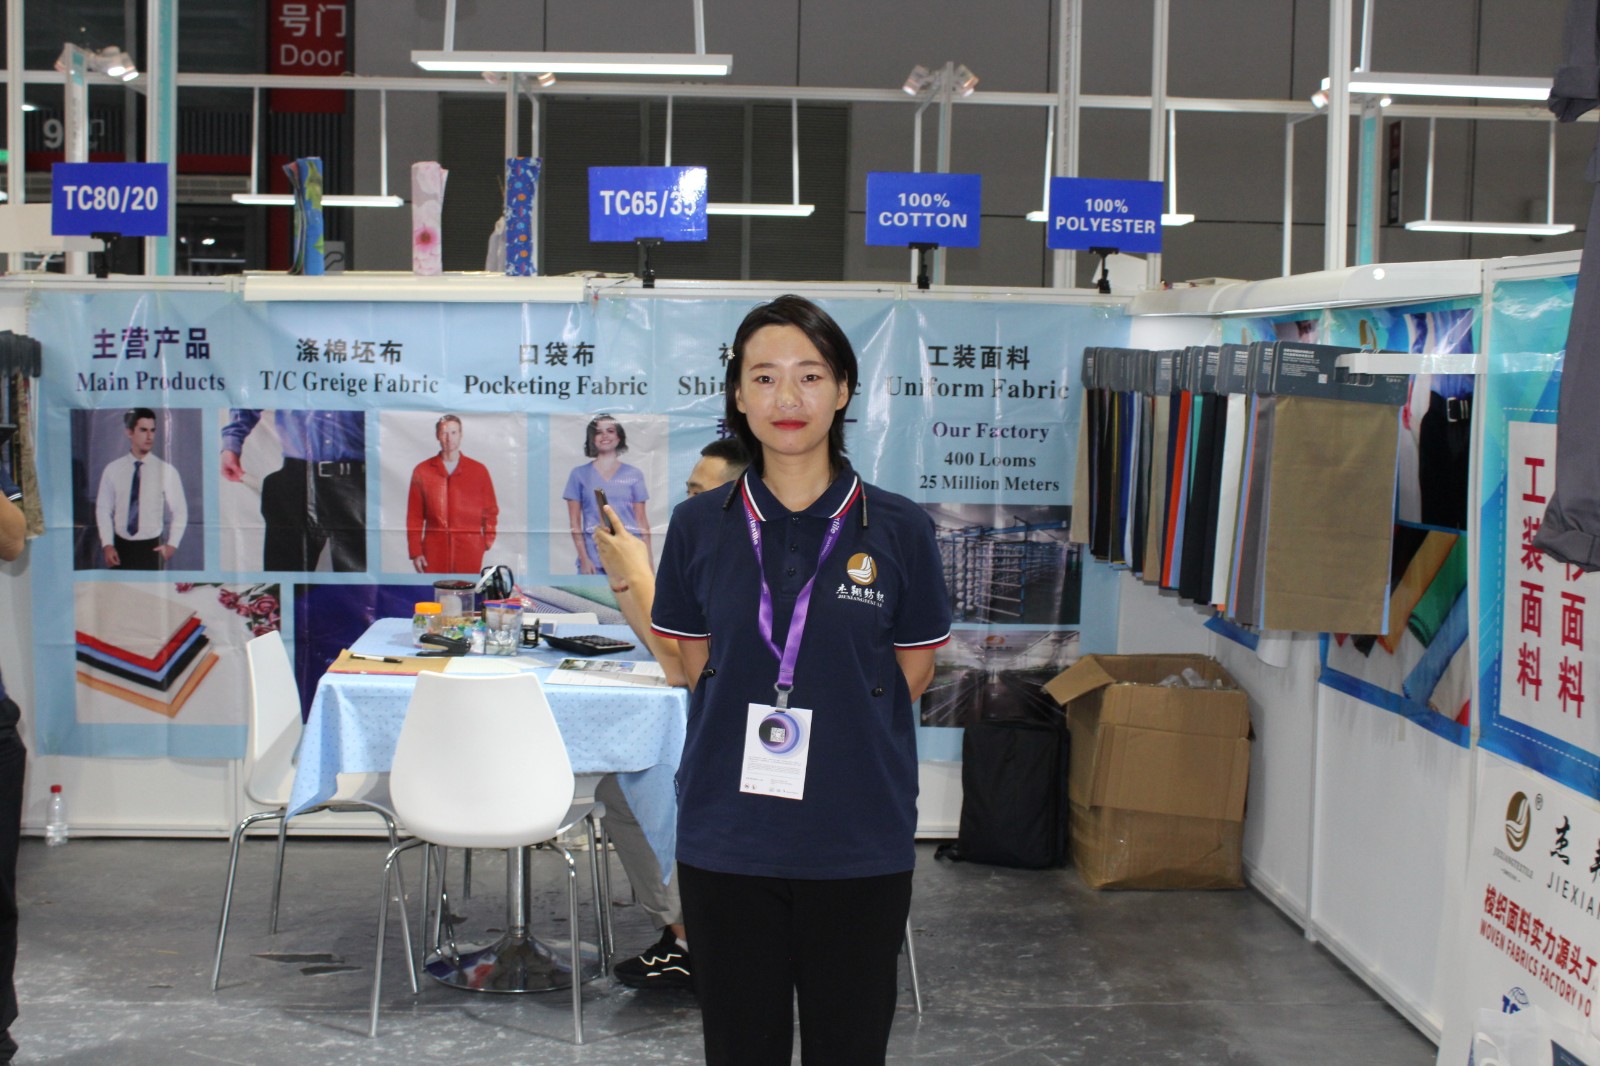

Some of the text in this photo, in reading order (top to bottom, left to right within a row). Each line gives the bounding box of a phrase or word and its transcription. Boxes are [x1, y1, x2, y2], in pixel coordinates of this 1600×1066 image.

[279, 3, 347, 37] 号门
[280, 44, 344, 67] Door
[43, 118, 63, 149] 9
[62, 185, 159, 213] TC80/20
[897, 192, 951, 208] 100%
[1085, 198, 1129, 213] 100%
[878, 211, 968, 228] COTTON
[1055, 216, 1156, 234] POLYESTER
[92, 326, 210, 360] 主营产品
[296, 338, 403, 365] 涤棉坯布
[518, 341, 595, 367] 口袋布
[927, 344, 1030, 370] 工装面料
[77, 371, 226, 392] Main Products
[260, 370, 439, 397] T/C Greige Fabric
[463, 375, 648, 400] Pocketing Fabric
[886, 376, 984, 398] Uniform
[991, 378, 1070, 400] Fabric
[932, 421, 1050, 442] Our Factory
[944, 451, 1036, 467] 400 Looms
[919, 475, 1060, 491] 25 Million Meters
[1516, 456, 1547, 702] 工装面料
[1557, 562, 1587, 719] 面料
[1479, 918, 1505, 951] WOVEN
[1505, 939, 1538, 977] FABRICS
[1538, 964, 1578, 1006] FACTORY
